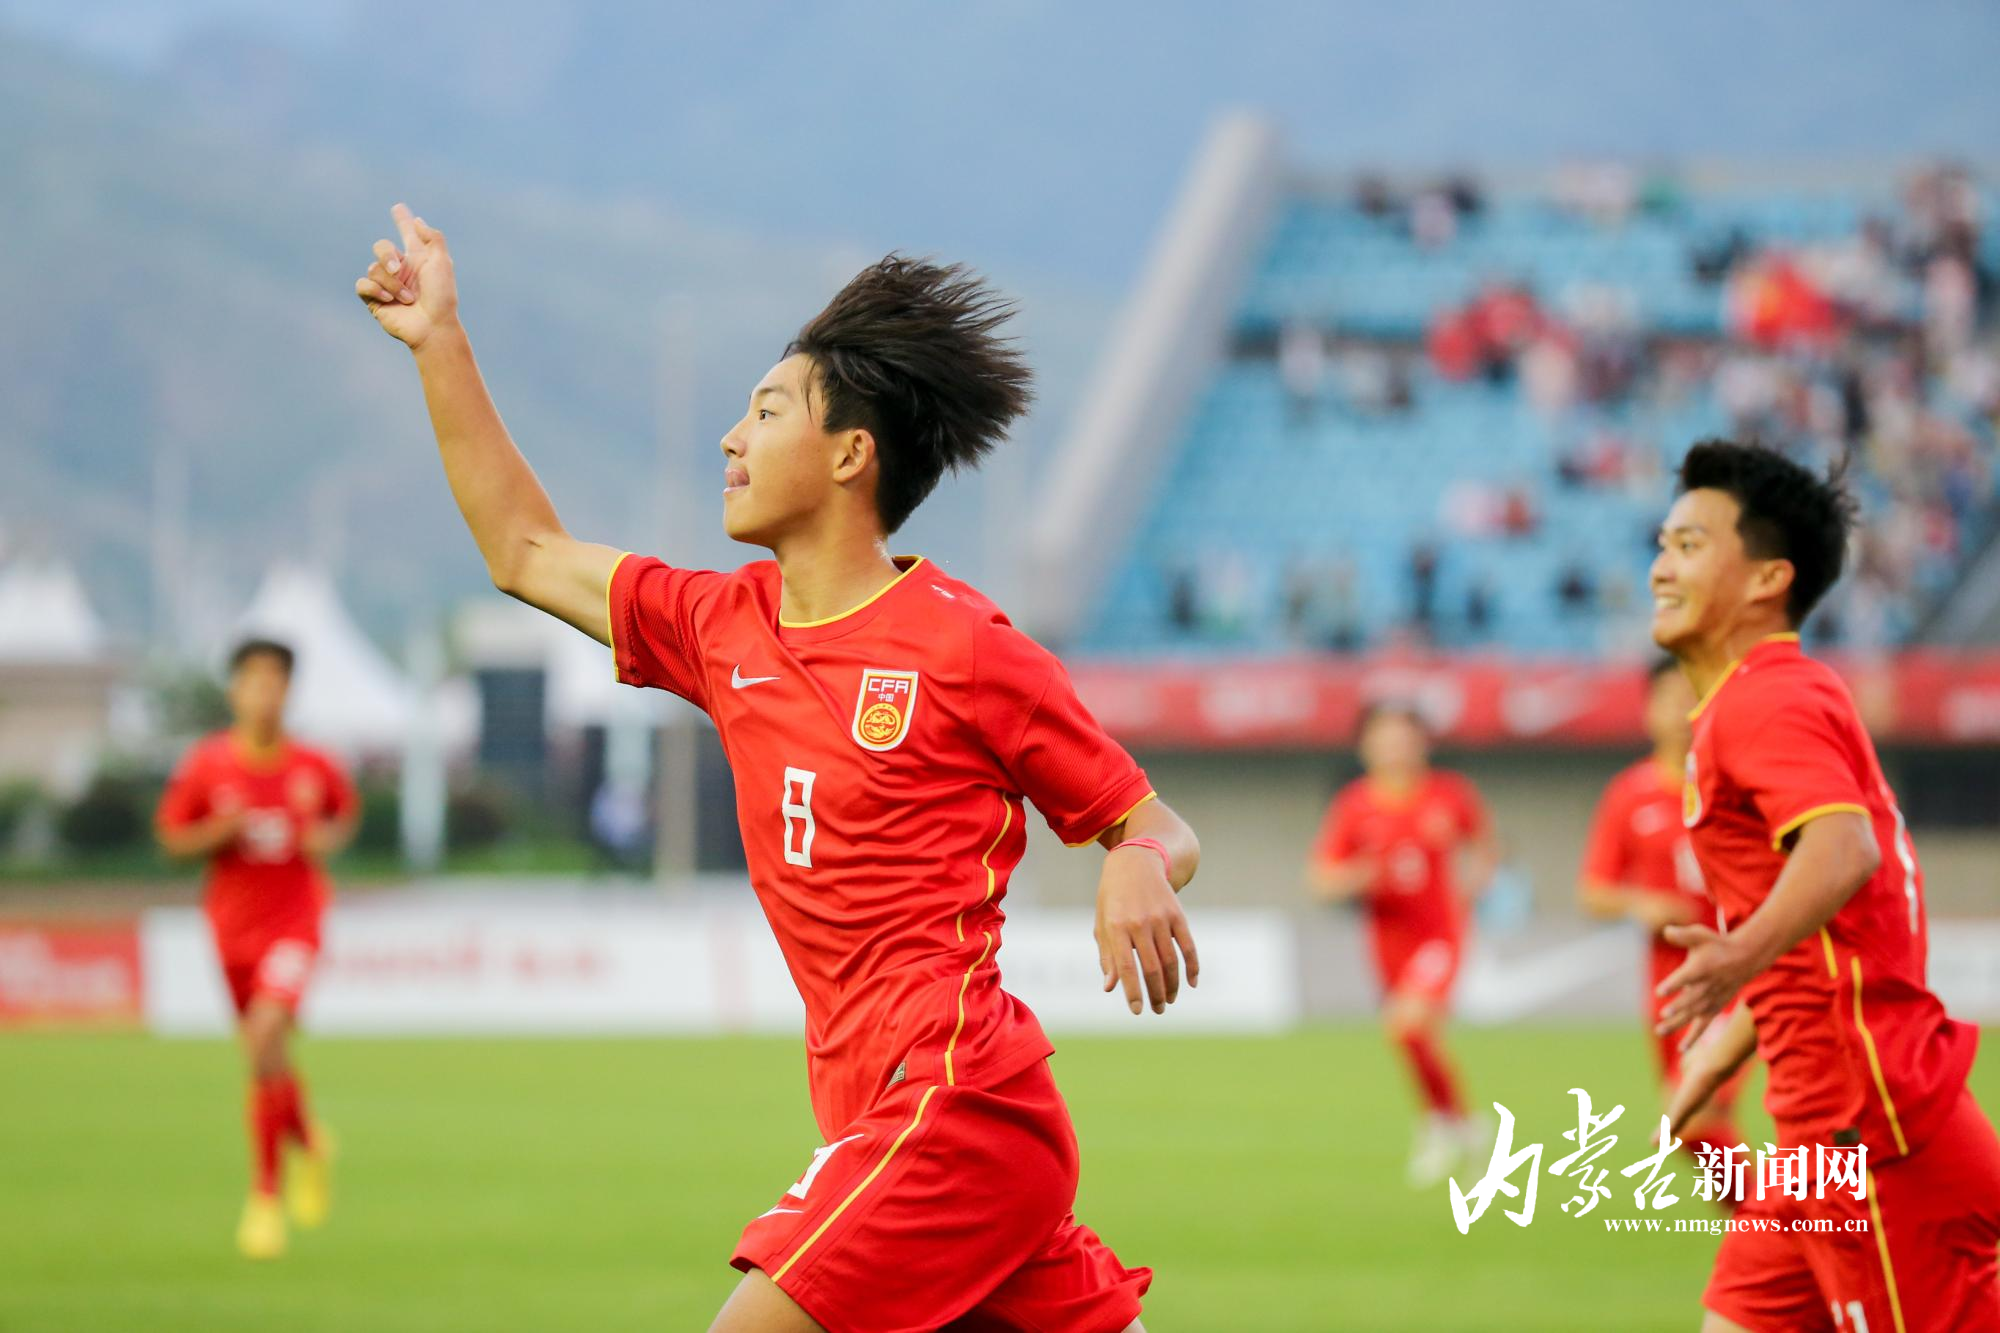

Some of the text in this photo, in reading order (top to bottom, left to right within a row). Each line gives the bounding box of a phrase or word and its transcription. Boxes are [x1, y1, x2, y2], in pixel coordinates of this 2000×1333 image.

[868, 678, 909, 694] CFA
[878, 693, 895, 702] 中国
[782, 766, 816, 868] 8
